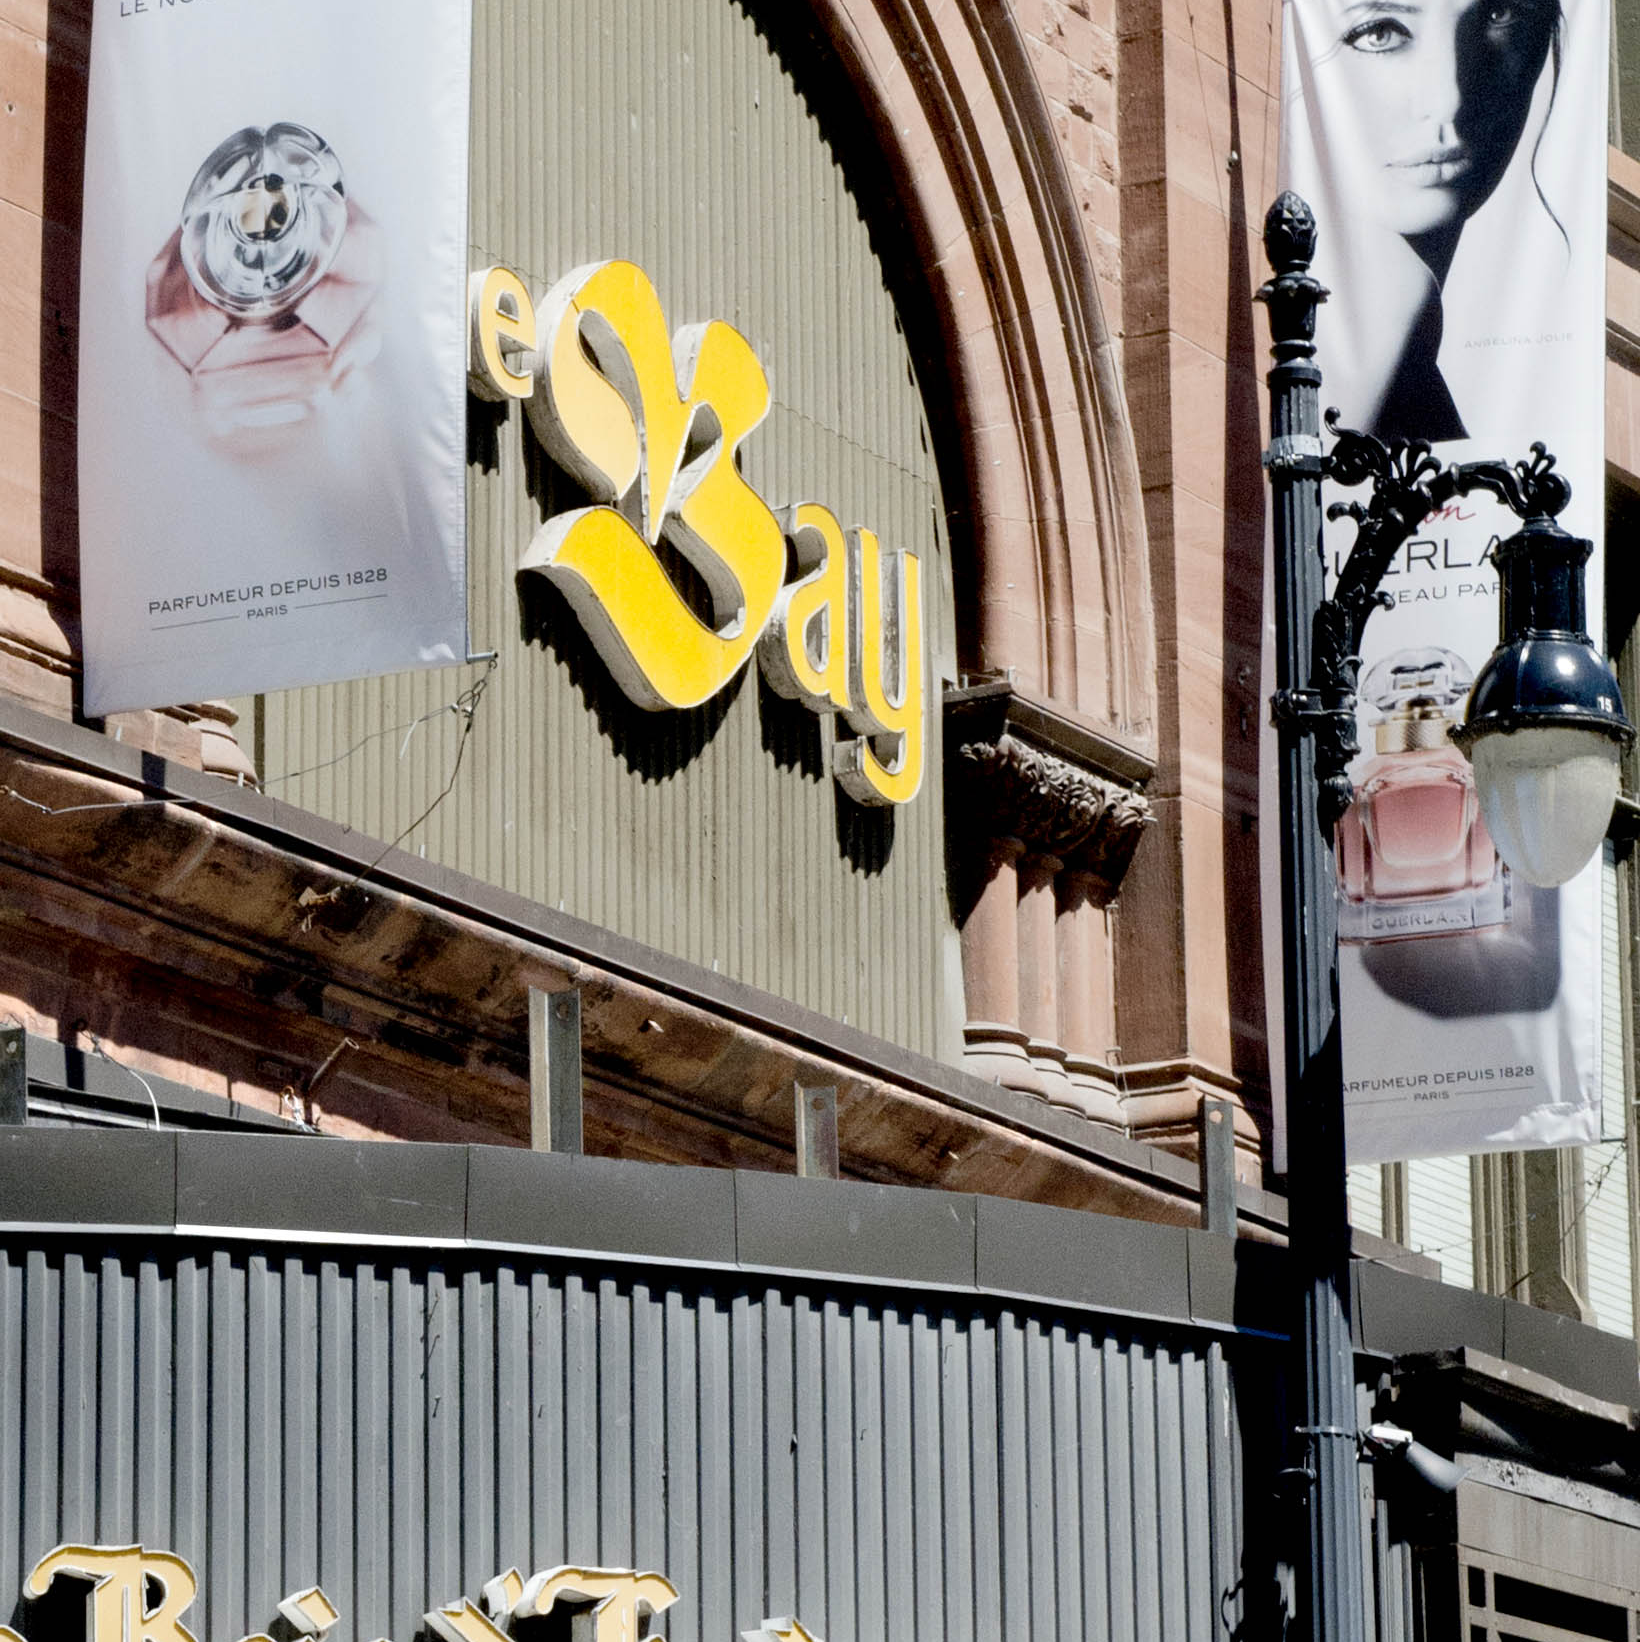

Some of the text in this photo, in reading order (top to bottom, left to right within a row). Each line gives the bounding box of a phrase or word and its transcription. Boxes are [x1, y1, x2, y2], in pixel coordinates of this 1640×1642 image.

[1423, 503, 1476, 525] on
[517, 259, 925, 806] Bay
[148, 568, 388, 615] PARFUMEUR DEPUIS 1828
[247, 604, 288, 620] PARIS
[1342, 1065, 1535, 1094] ARFUMEUR DEPUIS 1828
[1414, 1090, 1450, 1102] PARIS
